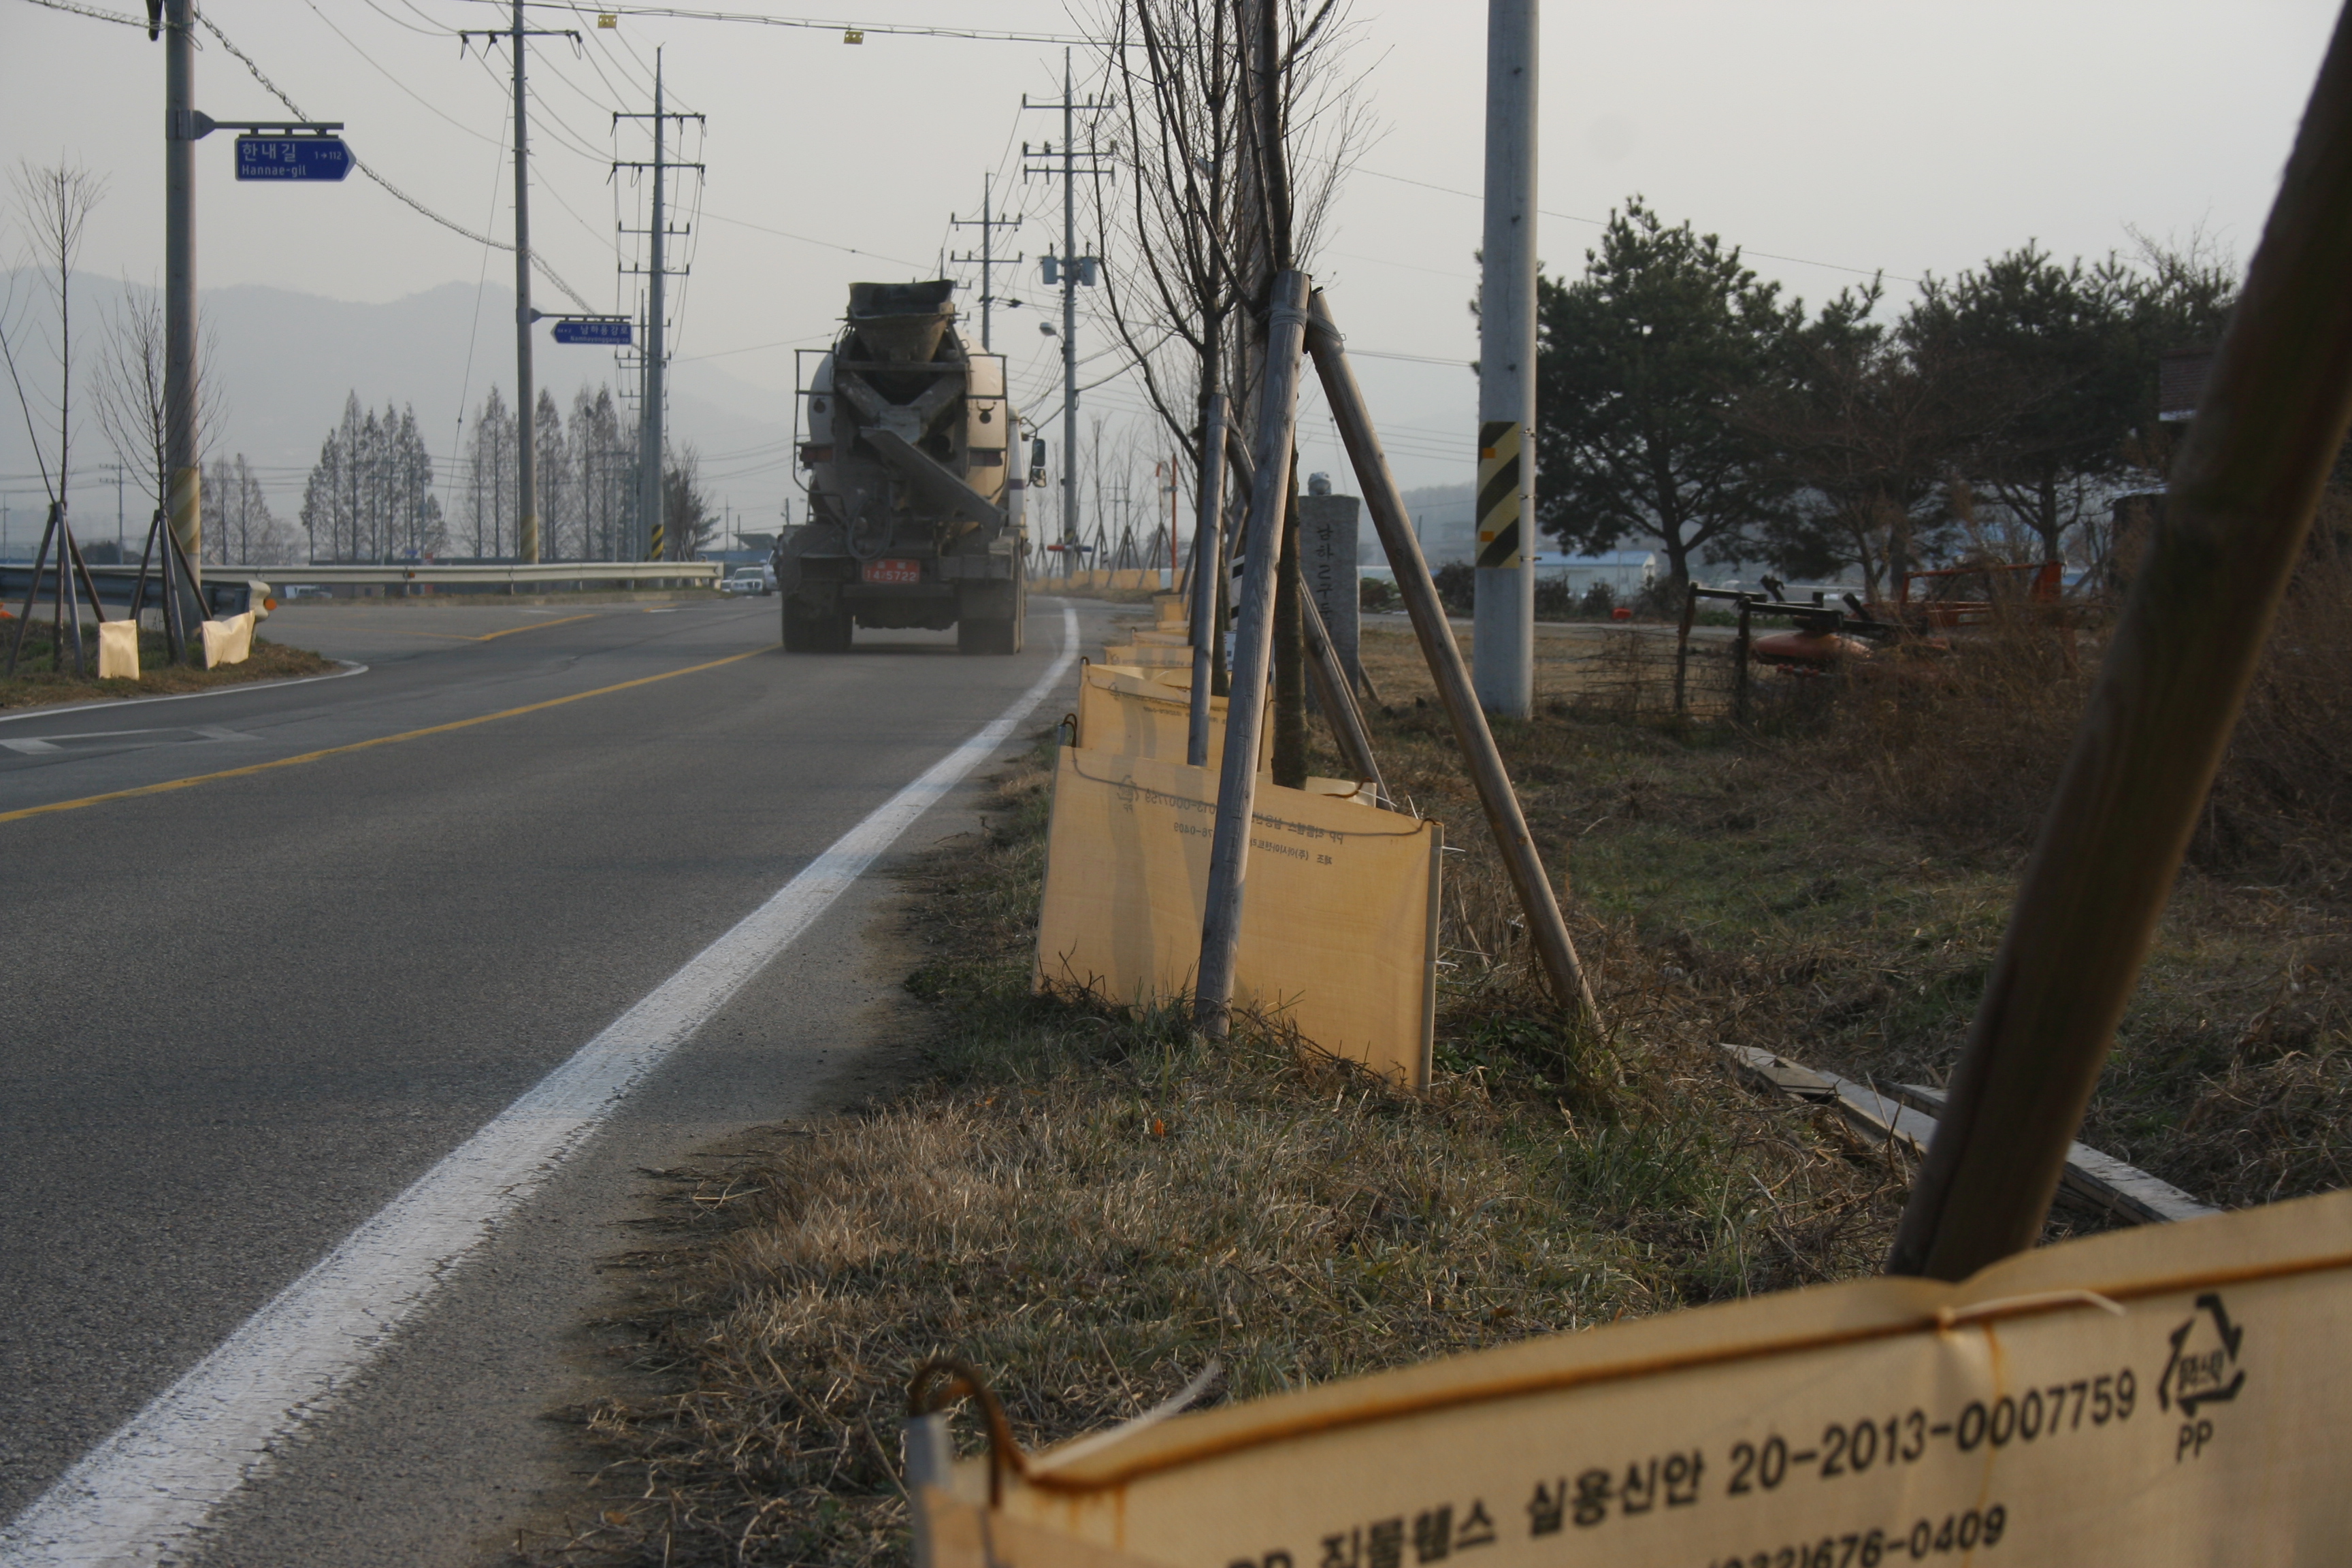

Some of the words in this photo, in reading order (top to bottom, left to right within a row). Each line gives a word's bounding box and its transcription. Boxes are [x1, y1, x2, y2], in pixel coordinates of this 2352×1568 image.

[242, 143, 296, 163] 한내길
[314, 151, 318, 160] 1
[329, 151, 342, 160] 112
[242, 165, 306, 178] Hannae-gil
[2176, 1419, 2214, 1463] PP
[1526, 1448, 1705, 1537] 실용신안
[1727, 1369, 2137, 1497] 20-2013-0007759
